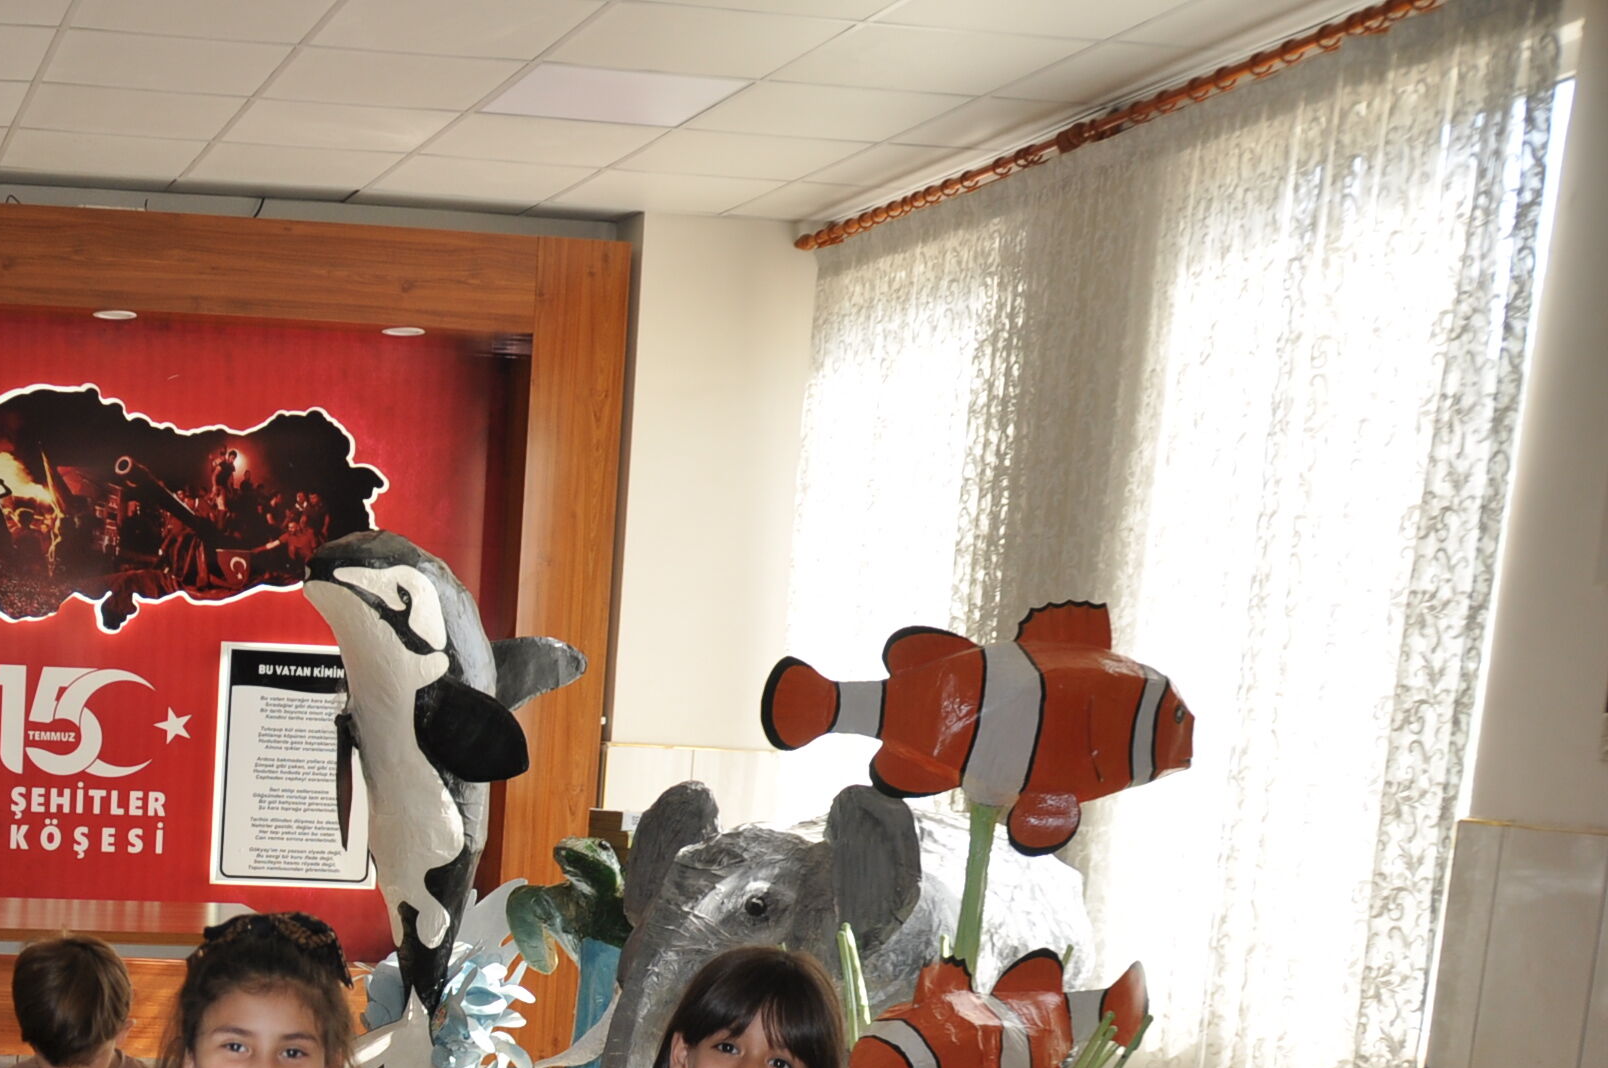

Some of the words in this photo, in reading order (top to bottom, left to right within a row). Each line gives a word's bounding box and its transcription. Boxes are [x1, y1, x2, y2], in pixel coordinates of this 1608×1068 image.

[258, 664, 273, 675] BU
[276, 665, 311, 677] VATAN
[28, 731, 75, 742] TEMMUZ
[10, 781, 166, 819] ŞEHİTLER
[9, 818, 164, 859] KÖŞESİ
